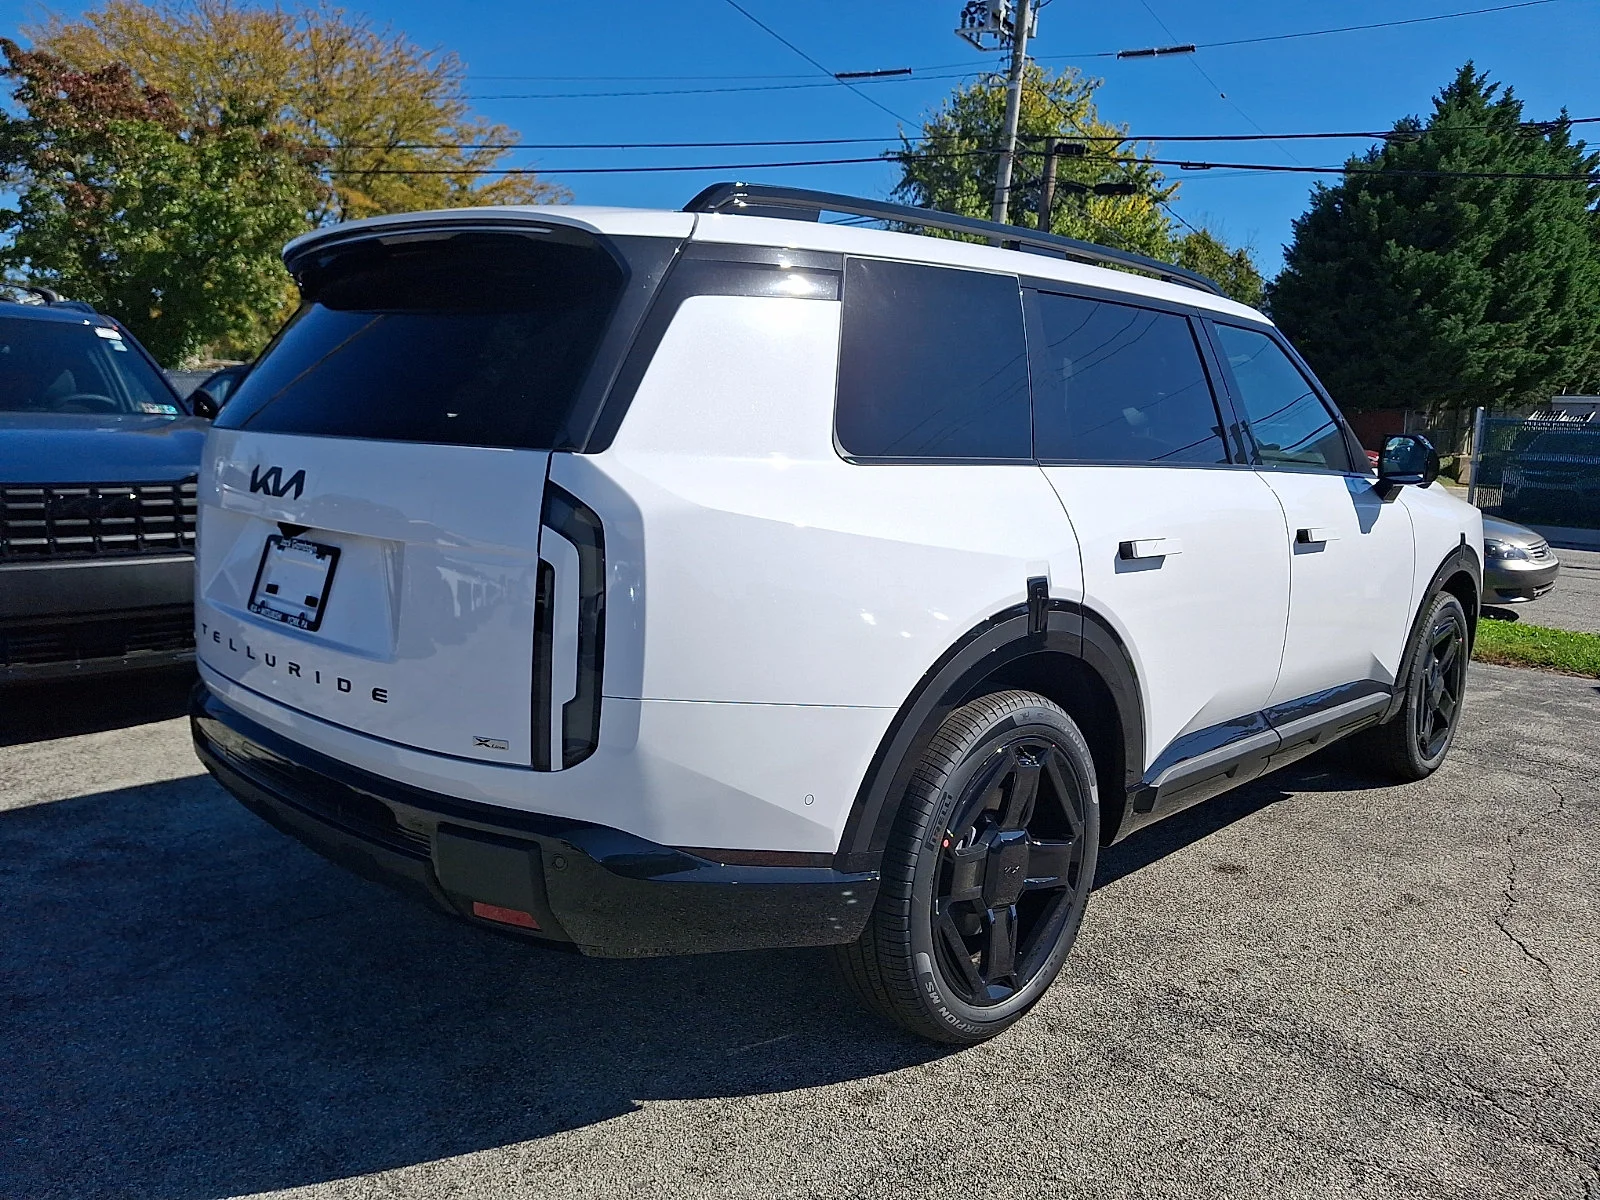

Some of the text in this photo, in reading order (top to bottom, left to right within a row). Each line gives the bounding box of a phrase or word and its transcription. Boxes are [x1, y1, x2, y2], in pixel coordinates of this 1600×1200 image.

[250, 465, 306, 500] KIA
[202, 623, 388, 704] TELLURIDE
[924, 791, 954, 852] PIRELLI
[924, 981, 941, 1005] MS
